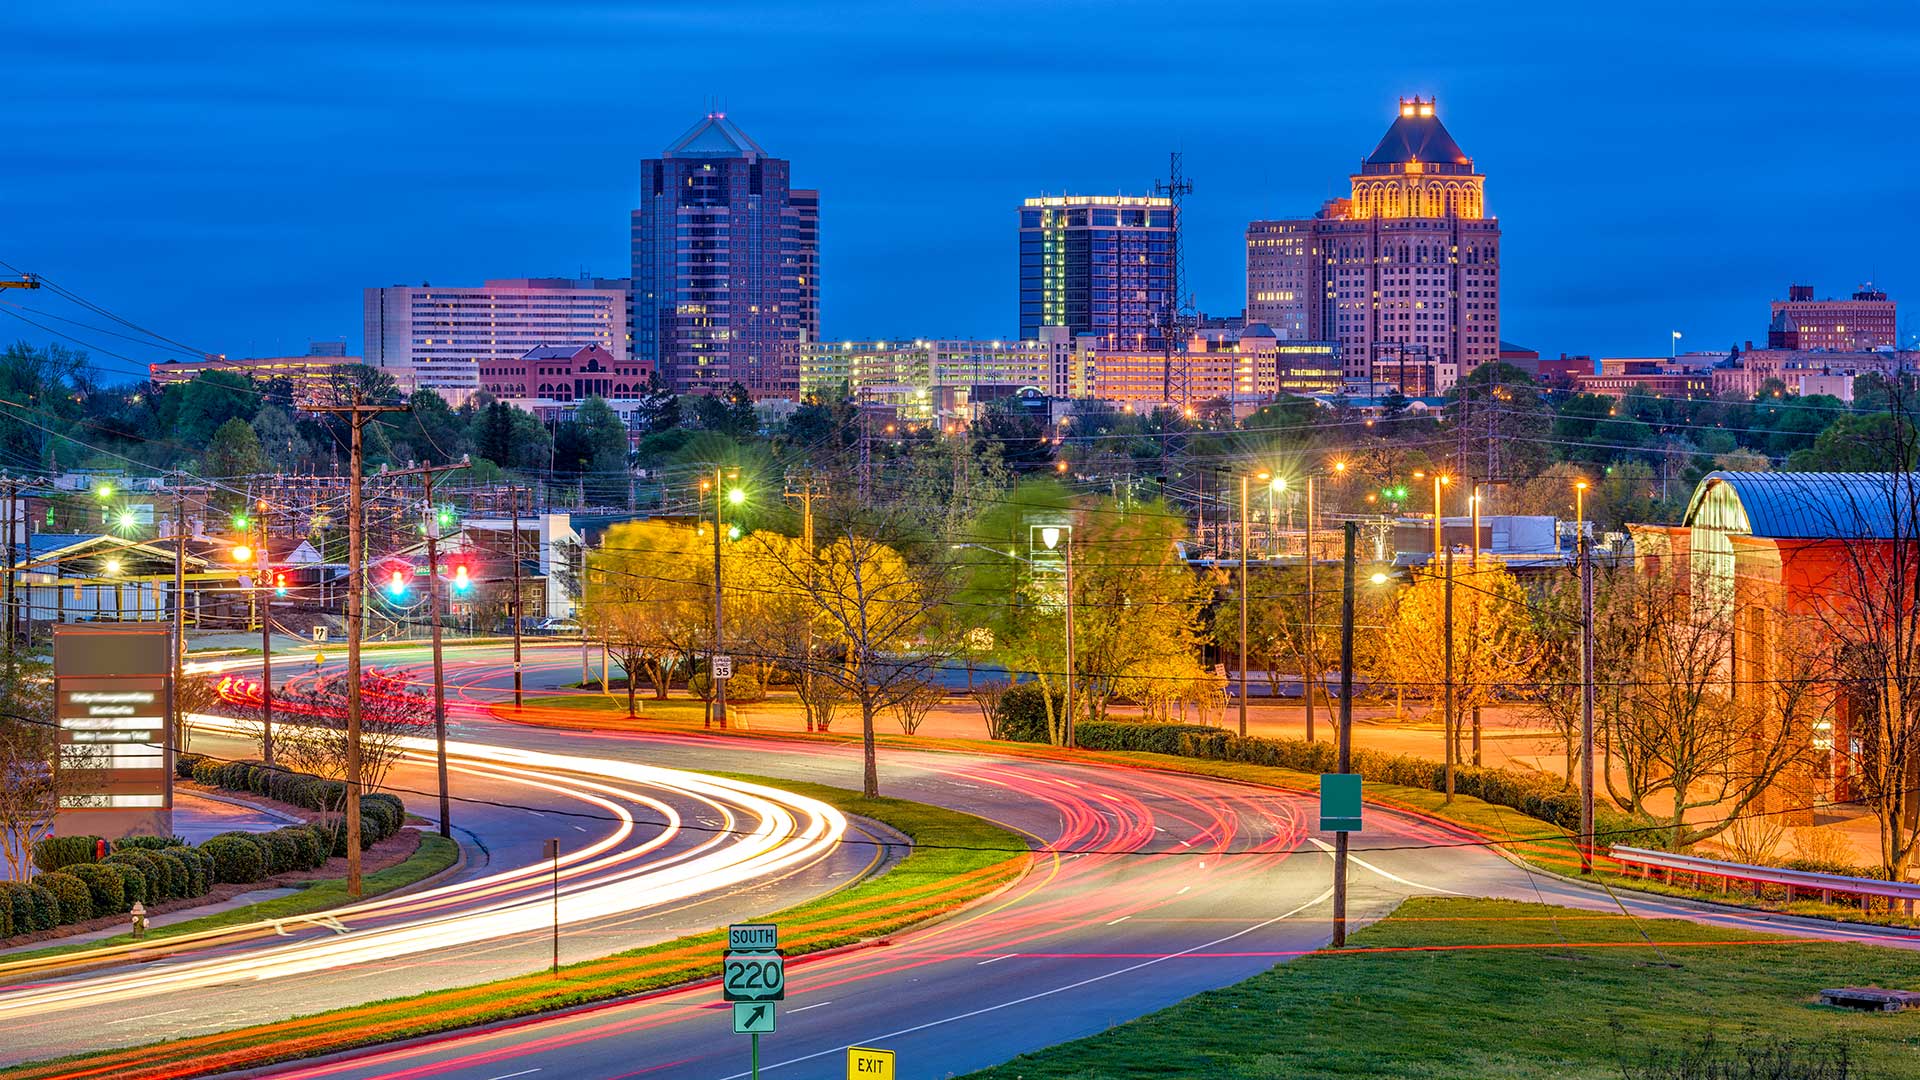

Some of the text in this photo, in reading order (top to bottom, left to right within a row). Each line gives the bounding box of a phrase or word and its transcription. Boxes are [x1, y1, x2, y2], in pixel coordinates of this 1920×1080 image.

[716, 668, 729, 676] 35
[732, 929, 774, 944] SOUTH
[728, 962, 780, 989] 220
[858, 1058, 884, 1074] EXIT
